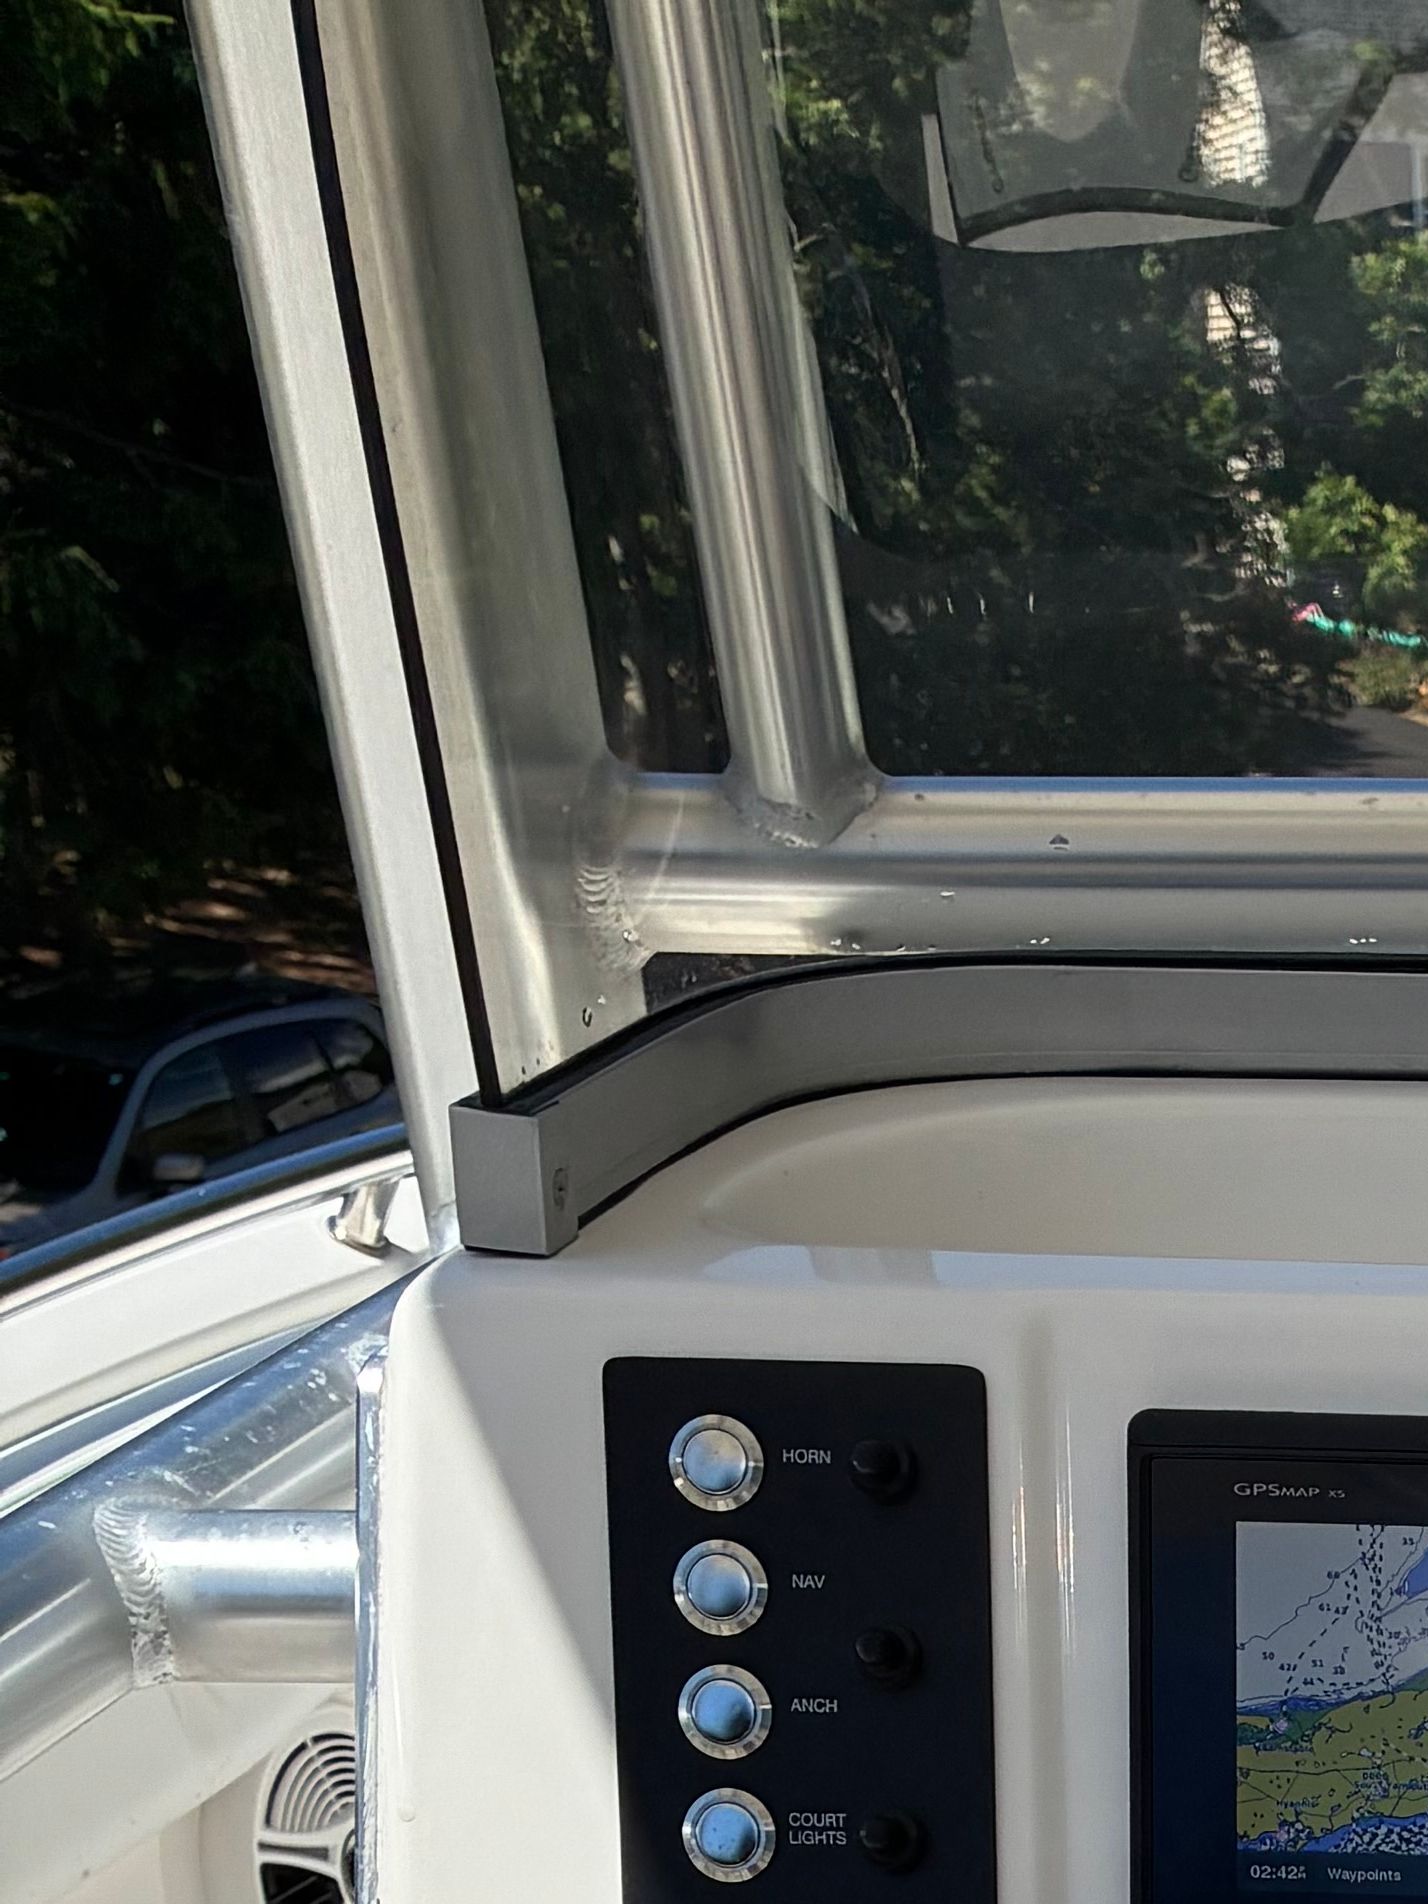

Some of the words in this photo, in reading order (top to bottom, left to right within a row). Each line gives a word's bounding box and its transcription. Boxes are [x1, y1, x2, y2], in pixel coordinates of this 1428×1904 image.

[782, 1448, 832, 1466] HORN
[1233, 1482, 1320, 1497] GPSMAP
[791, 1574, 826, 1591] NAV
[790, 1698, 839, 1715] ANCH
[788, 1813, 847, 1829] COURT
[787, 1831, 847, 1847] LIGHTS
[1327, 1867, 1402, 1883] Waypoints
